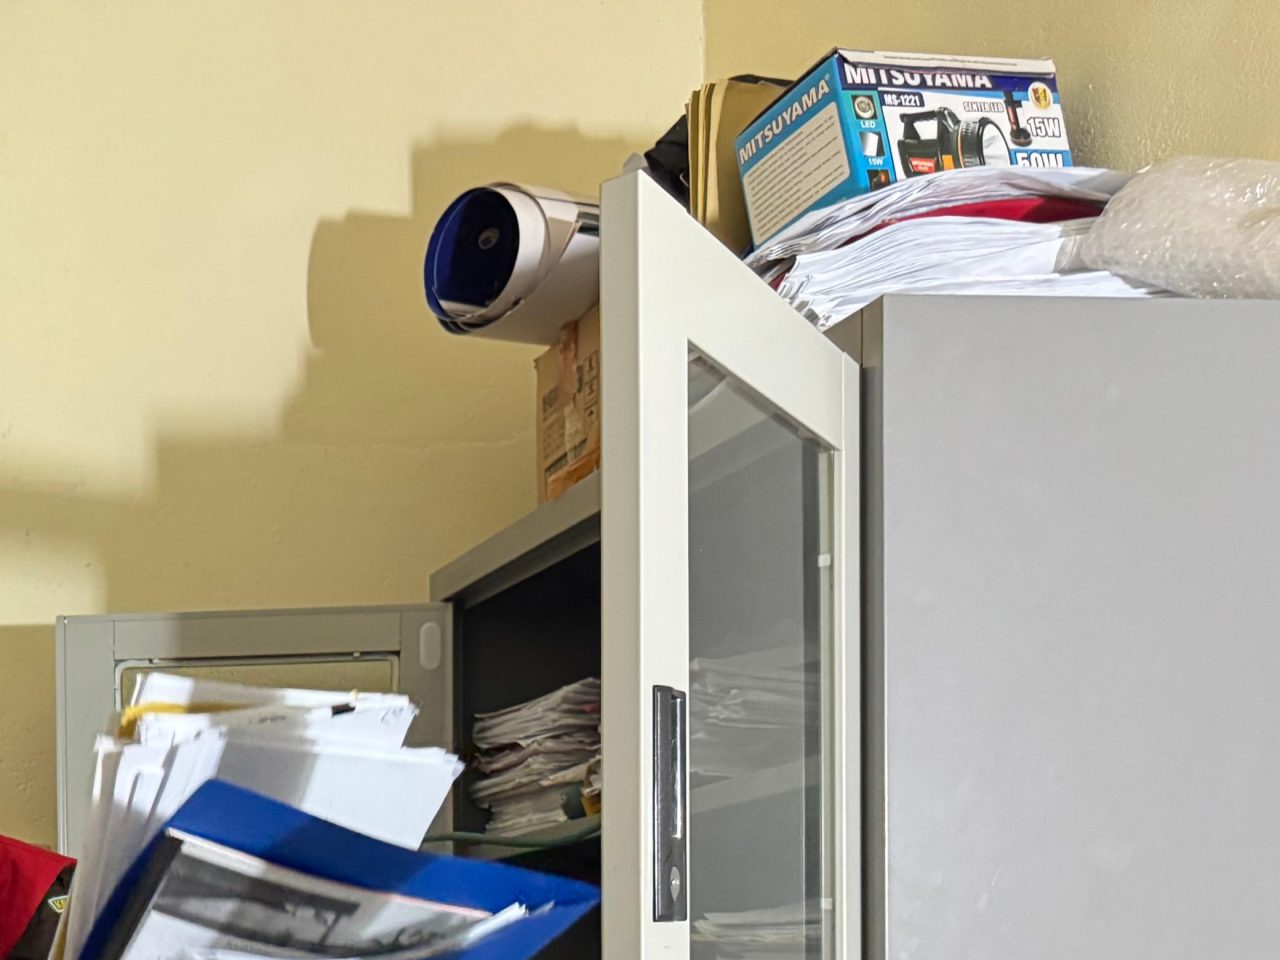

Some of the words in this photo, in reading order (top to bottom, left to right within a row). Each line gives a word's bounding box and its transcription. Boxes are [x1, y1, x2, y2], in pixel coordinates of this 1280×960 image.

[843, 62, 993, 88] MITSUYAMA
[884, 93, 920, 106] MS-1221
[738, 79, 830, 164] MITSUYAMA
[860, 120, 876, 129] LED
[1027, 117, 1061, 138] 15W
